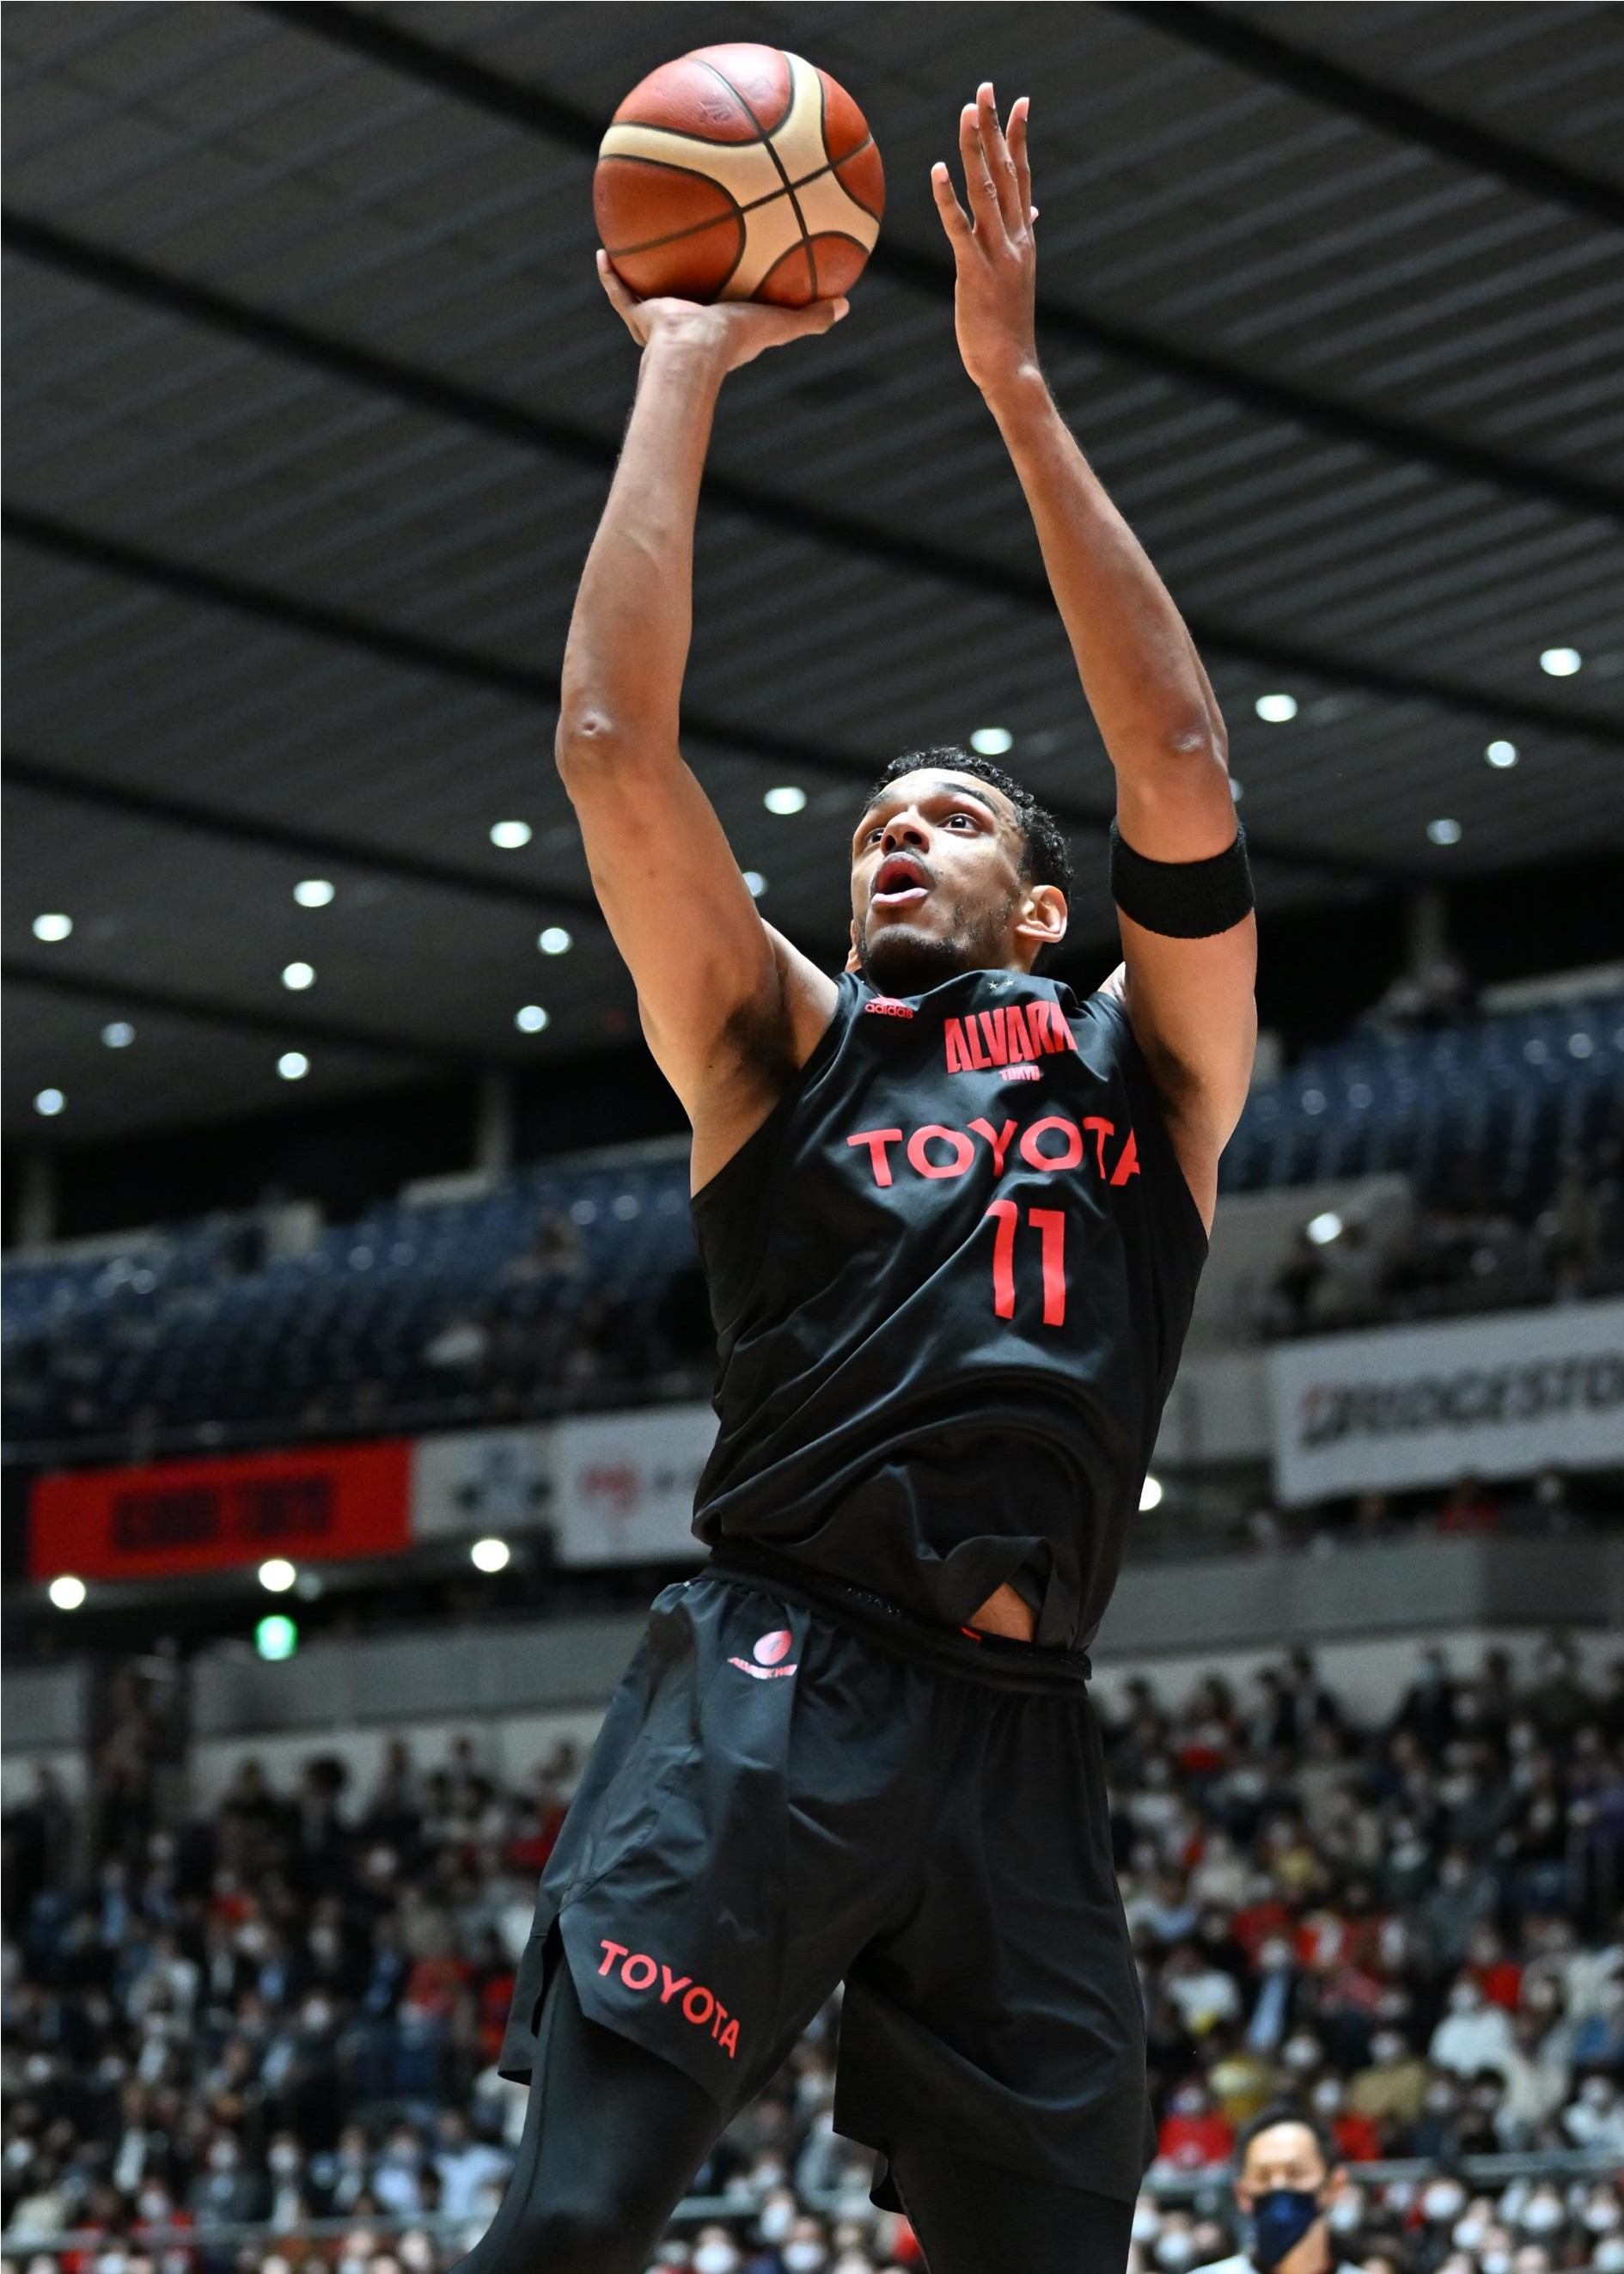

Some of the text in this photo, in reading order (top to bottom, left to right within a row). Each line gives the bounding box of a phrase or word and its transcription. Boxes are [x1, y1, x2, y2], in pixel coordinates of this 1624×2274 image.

[864, 1002, 914, 1019] adidas
[846, 1116, 1141, 1187] TOYOTA
[986, 1199, 1066, 1327] 11
[597, 1939, 740, 2059] TOYOTA
